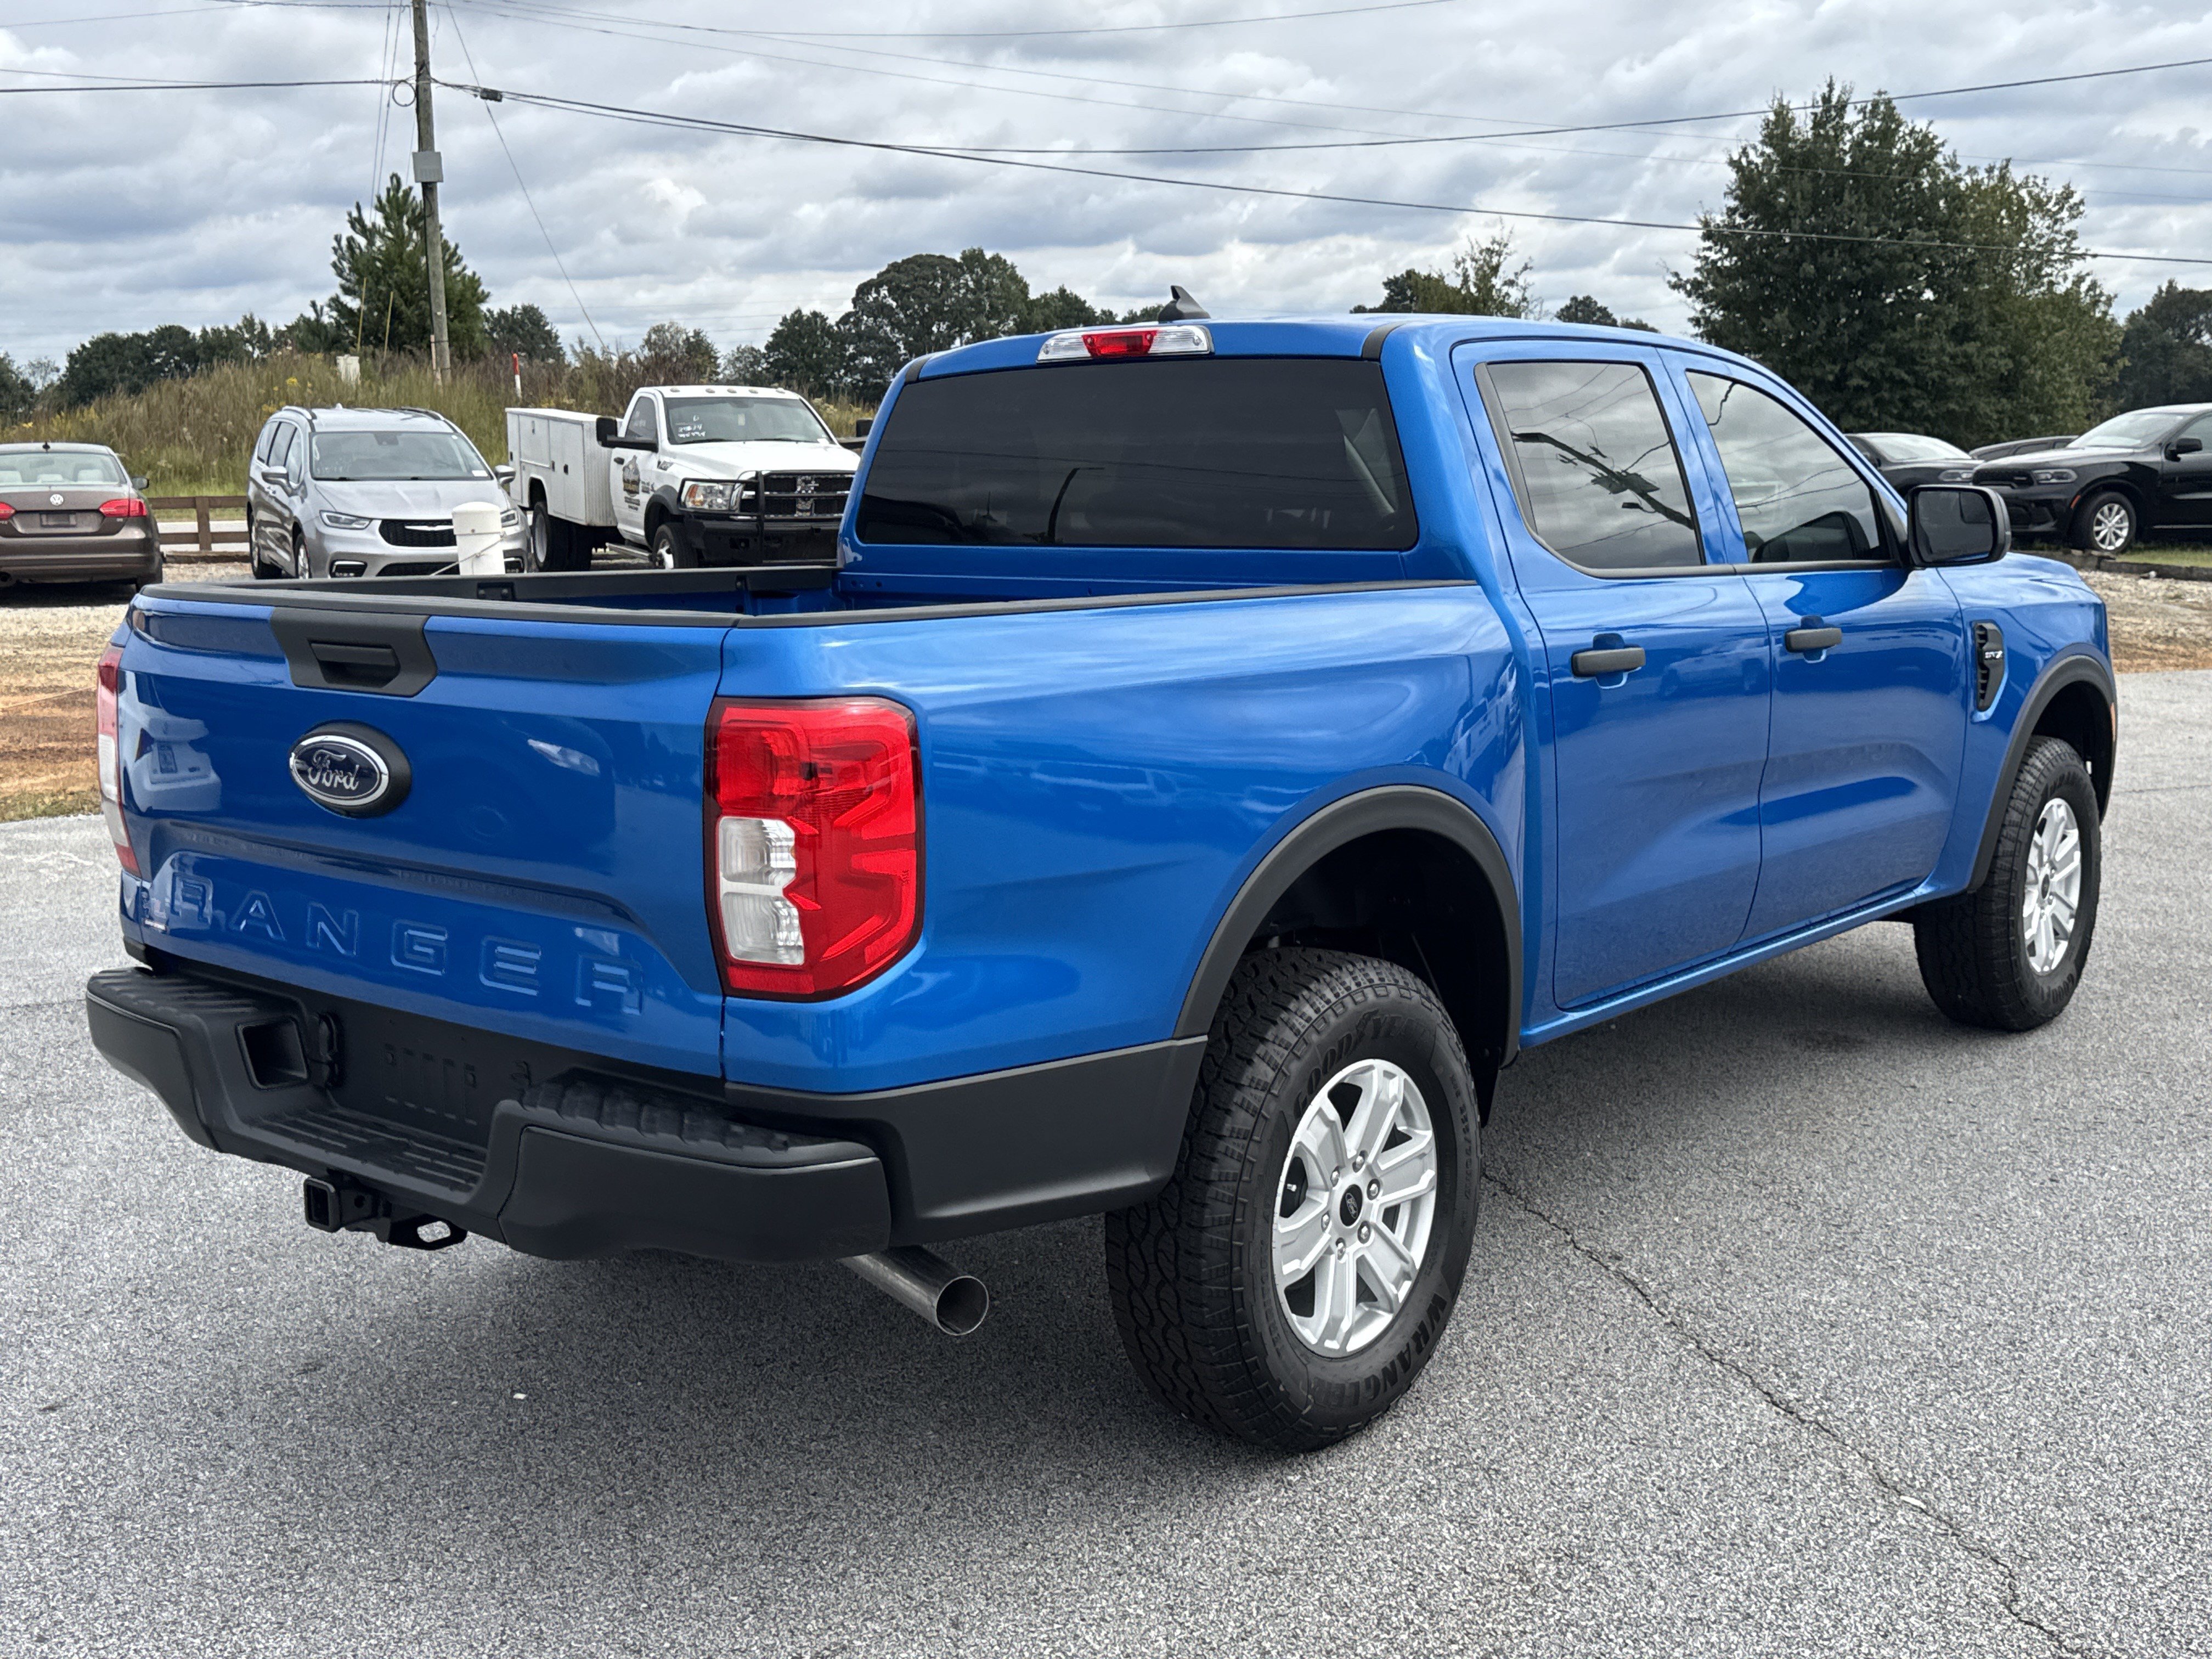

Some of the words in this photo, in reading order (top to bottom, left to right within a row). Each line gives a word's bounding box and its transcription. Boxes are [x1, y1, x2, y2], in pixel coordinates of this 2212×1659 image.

[307, 749, 360, 791] Ford
[171, 873, 643, 1015] RANGER
[1312, 1293, 1447, 1408] WRANGLER
